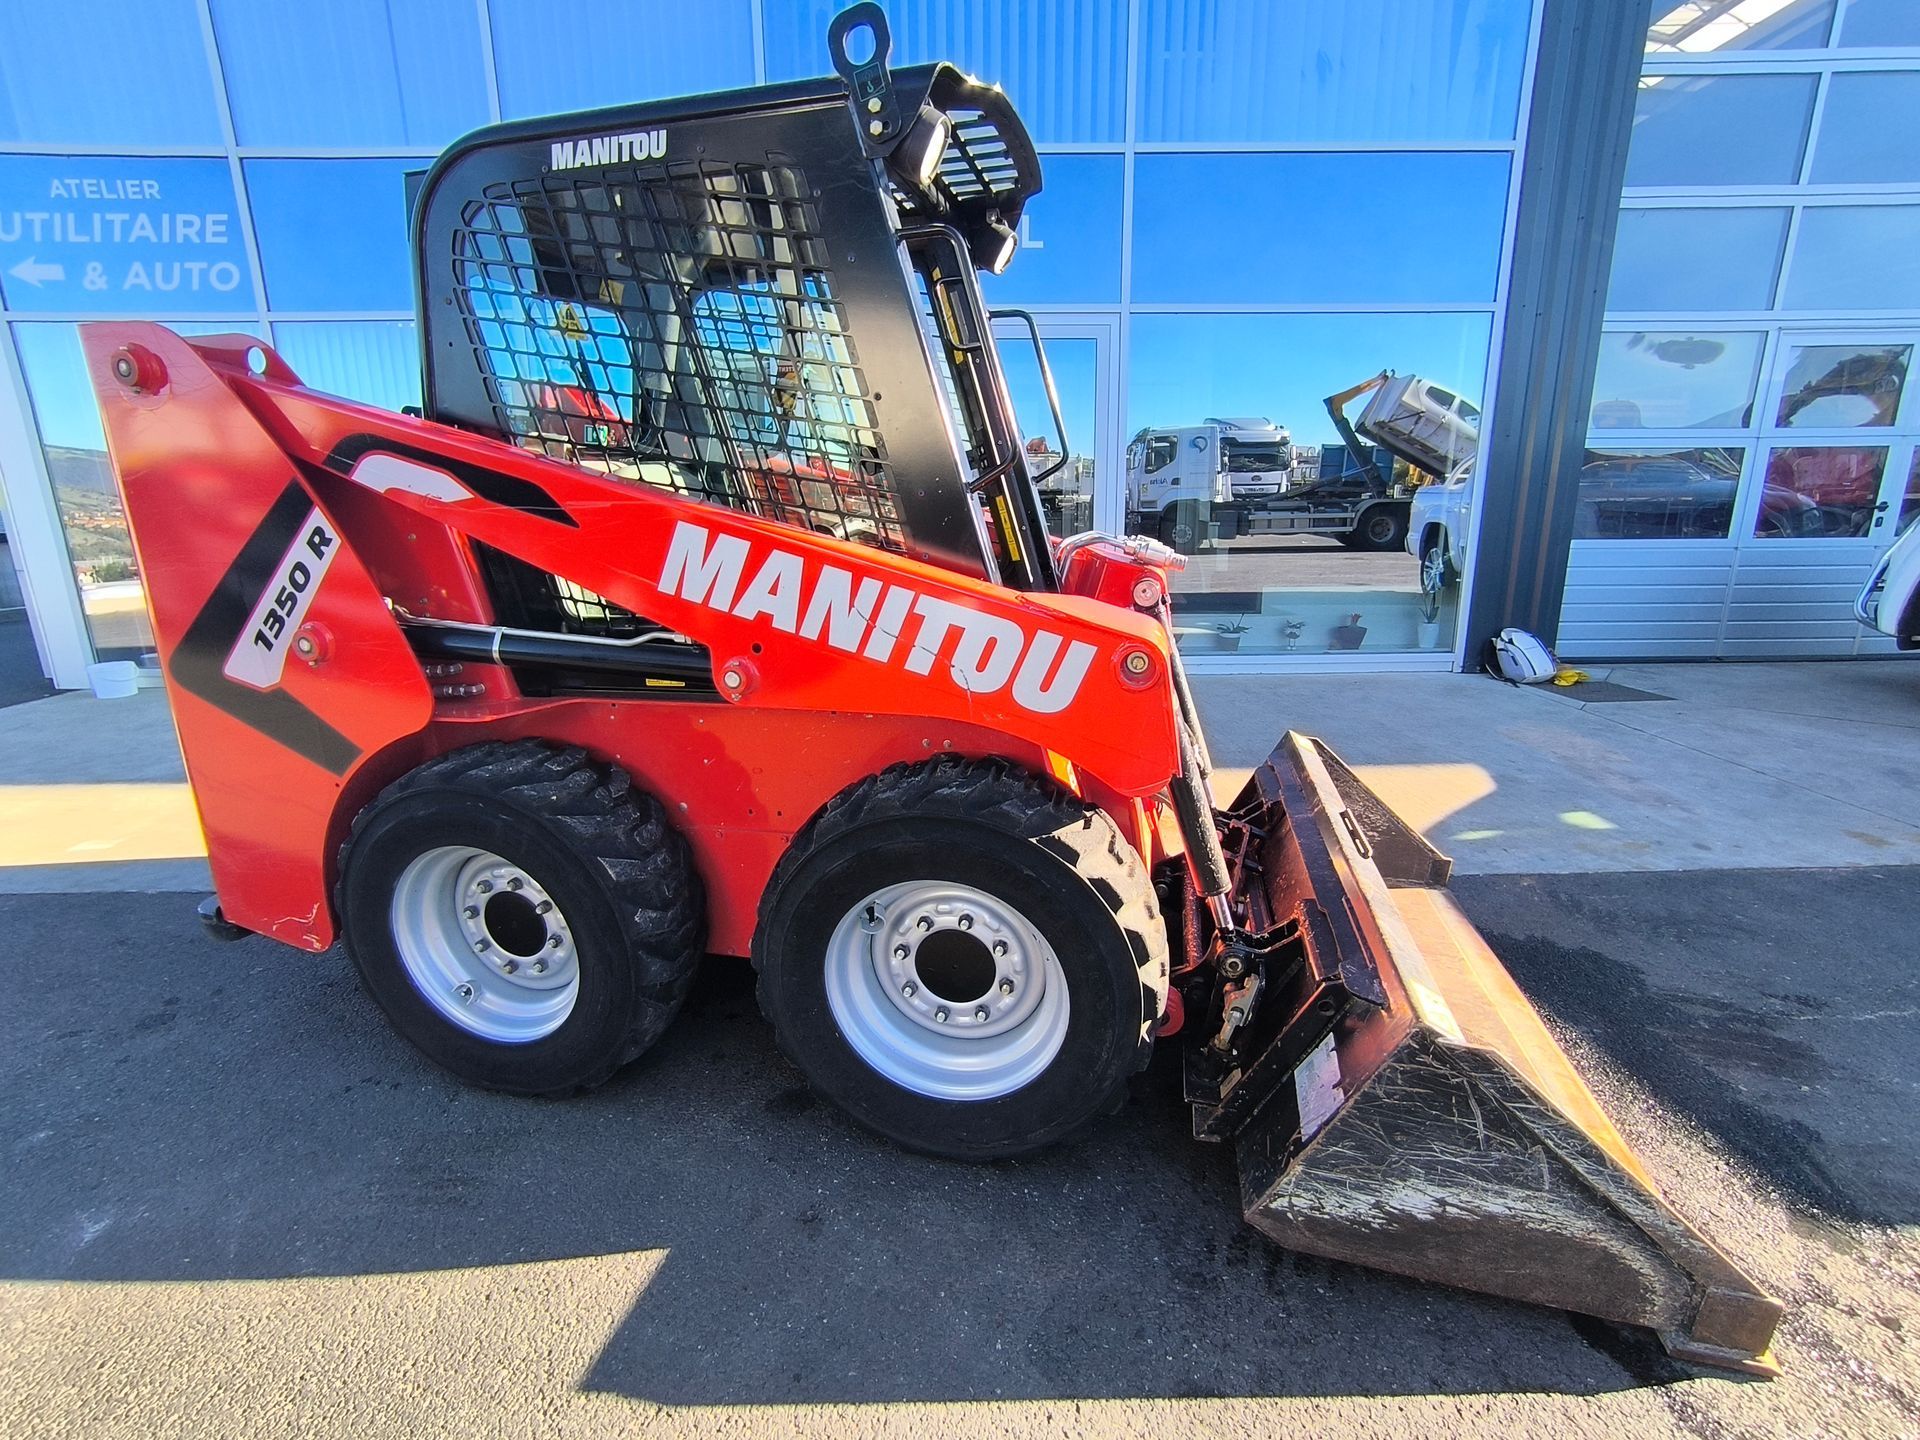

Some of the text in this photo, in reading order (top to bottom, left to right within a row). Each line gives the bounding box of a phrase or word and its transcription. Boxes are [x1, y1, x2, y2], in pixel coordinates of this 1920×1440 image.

[551, 129, 667, 171] MANITOU
[50, 178, 162, 200] ATELIER
[0, 211, 229, 243] UTILITAIRE
[82, 261, 241, 291] & AUTO
[253, 525, 334, 653] 1350 R
[656, 519, 1098, 714] MANITOU
